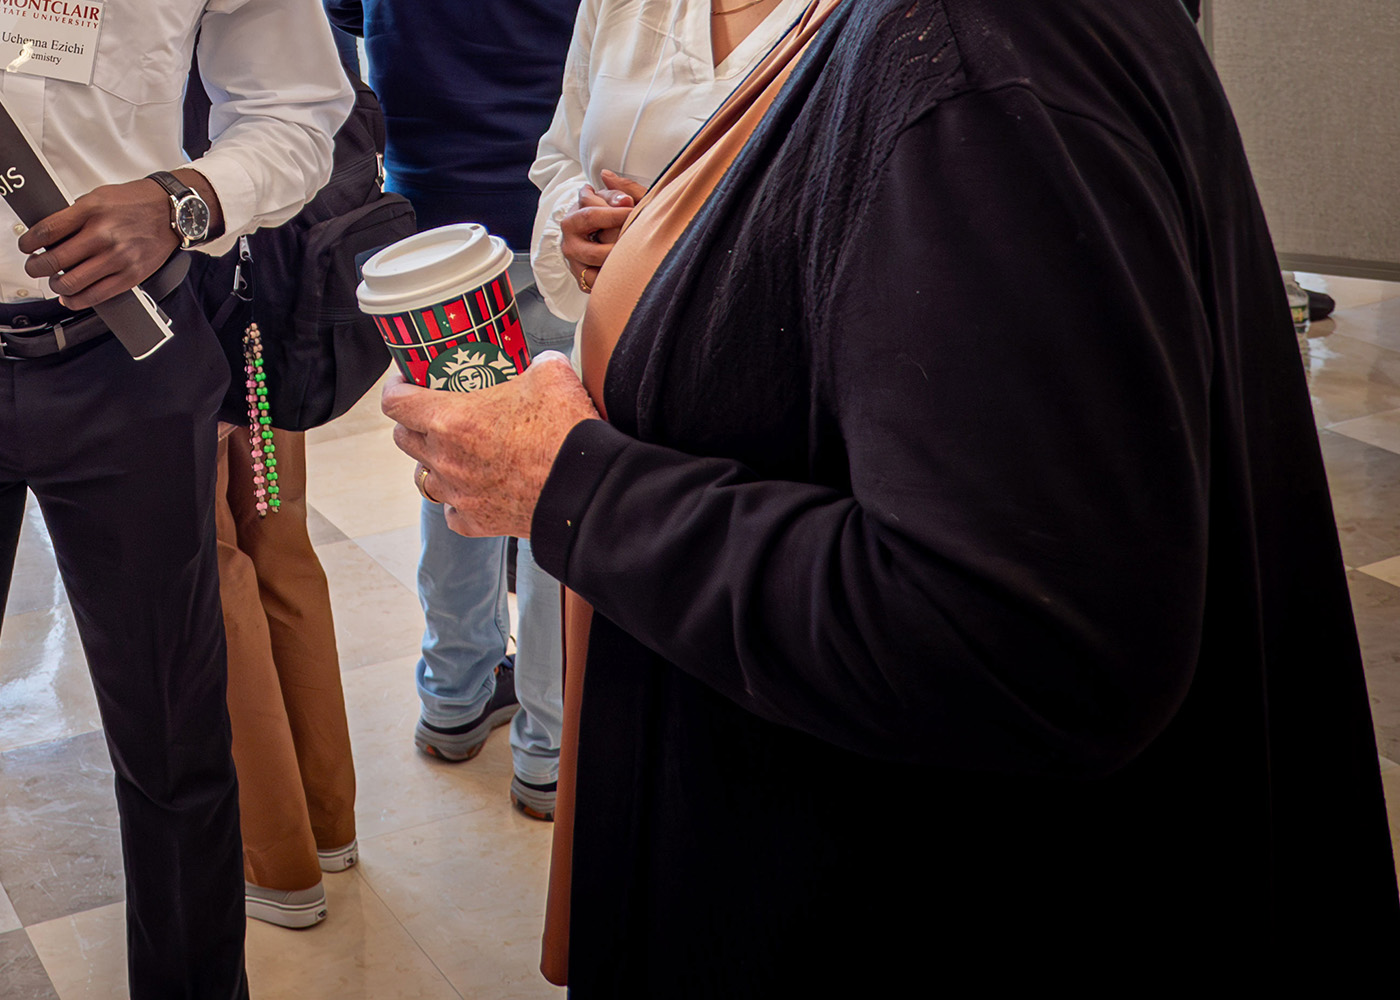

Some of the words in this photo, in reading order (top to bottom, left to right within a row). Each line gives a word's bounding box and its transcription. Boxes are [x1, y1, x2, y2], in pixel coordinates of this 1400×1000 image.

[33, 12, 99, 29] UNIVERSITY
[2, 31, 47, 49] Uchenna
[51, 40, 84, 55] Ezichi
